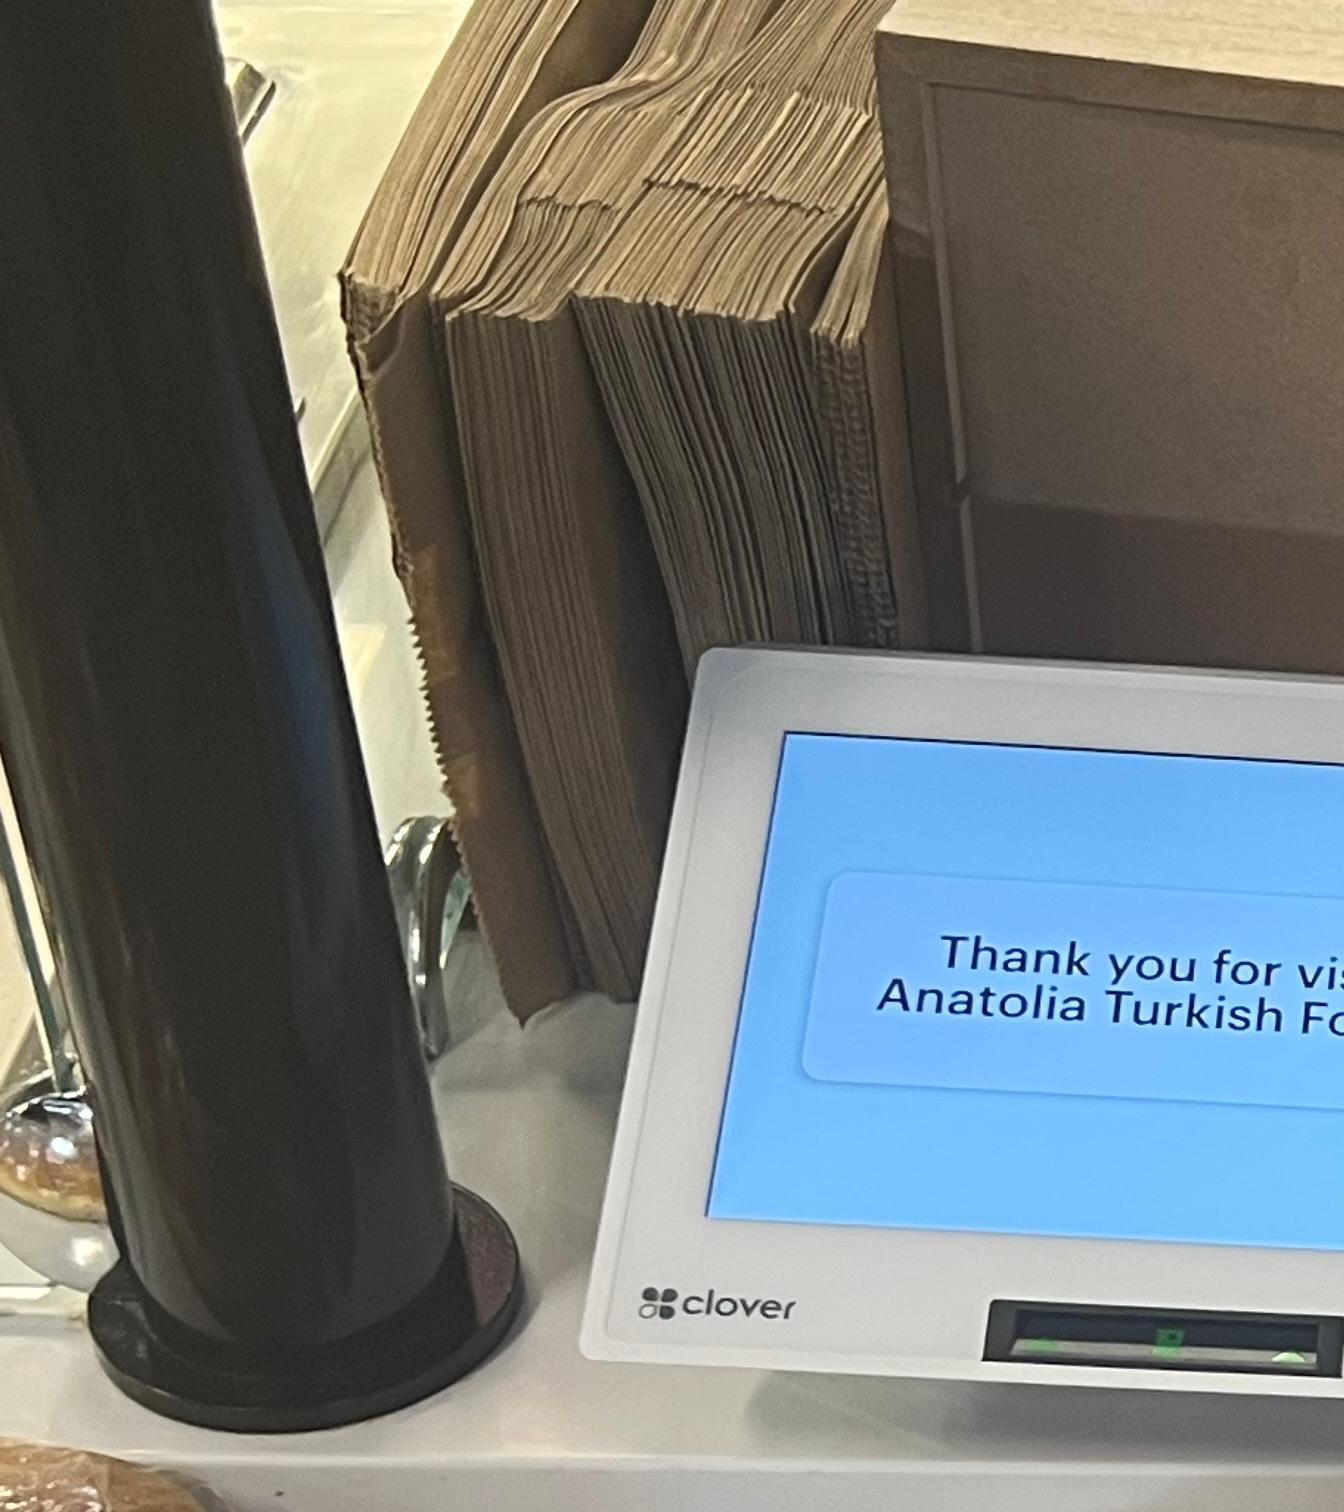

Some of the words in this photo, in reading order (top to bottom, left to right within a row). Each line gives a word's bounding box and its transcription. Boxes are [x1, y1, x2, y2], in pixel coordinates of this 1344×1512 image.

[940, 933, 1092, 978] Thank
[1108, 943, 1199, 987] you
[1212, 946, 1283, 987] for
[876, 976, 1088, 1024] Anatolia
[1105, 988, 1284, 1035] Turkish
[682, 1288, 797, 1320] clover
